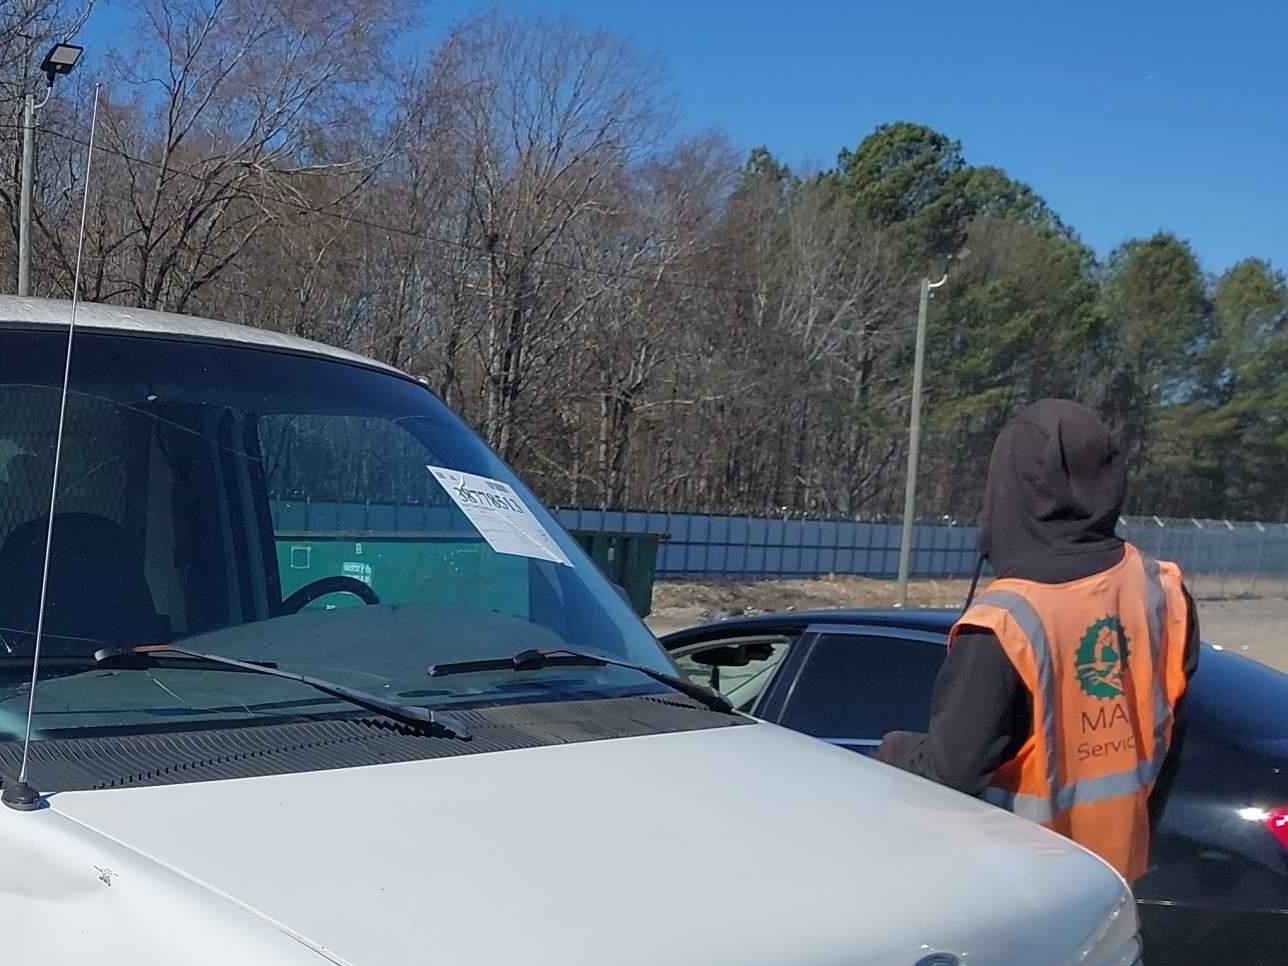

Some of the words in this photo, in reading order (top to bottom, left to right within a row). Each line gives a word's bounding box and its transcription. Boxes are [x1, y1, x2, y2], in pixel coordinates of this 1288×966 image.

[453, 486, 524, 513] 38778513
[1081, 703, 1129, 734] MA
[1077, 735, 1135, 761] Servic
